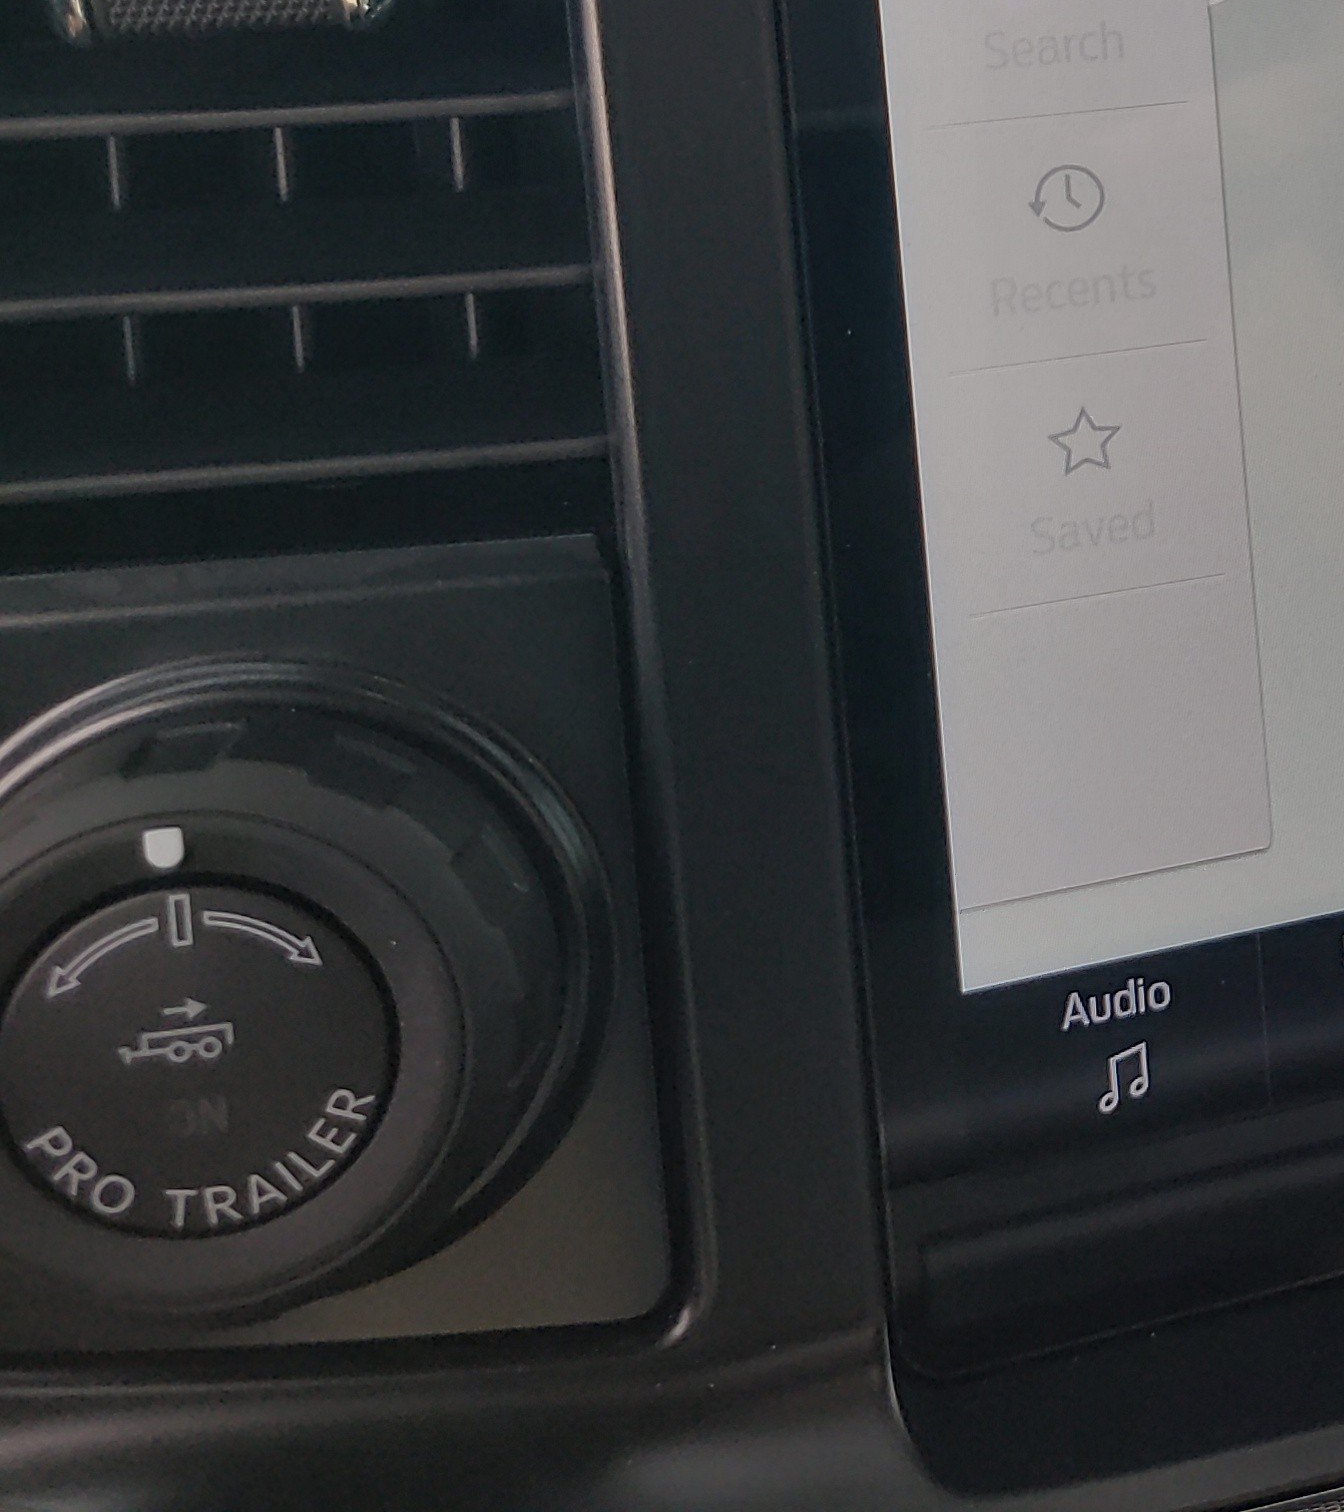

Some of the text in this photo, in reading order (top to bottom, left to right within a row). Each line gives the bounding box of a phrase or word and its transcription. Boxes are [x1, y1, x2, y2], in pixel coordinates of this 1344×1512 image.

[984, 19, 1126, 71] Search
[989, 263, 1158, 318] Recents
[1030, 498, 1157, 555] Saved
[1060, 976, 1172, 1033] Audio
[25, 1085, 377, 1229] PRO TRAILER
